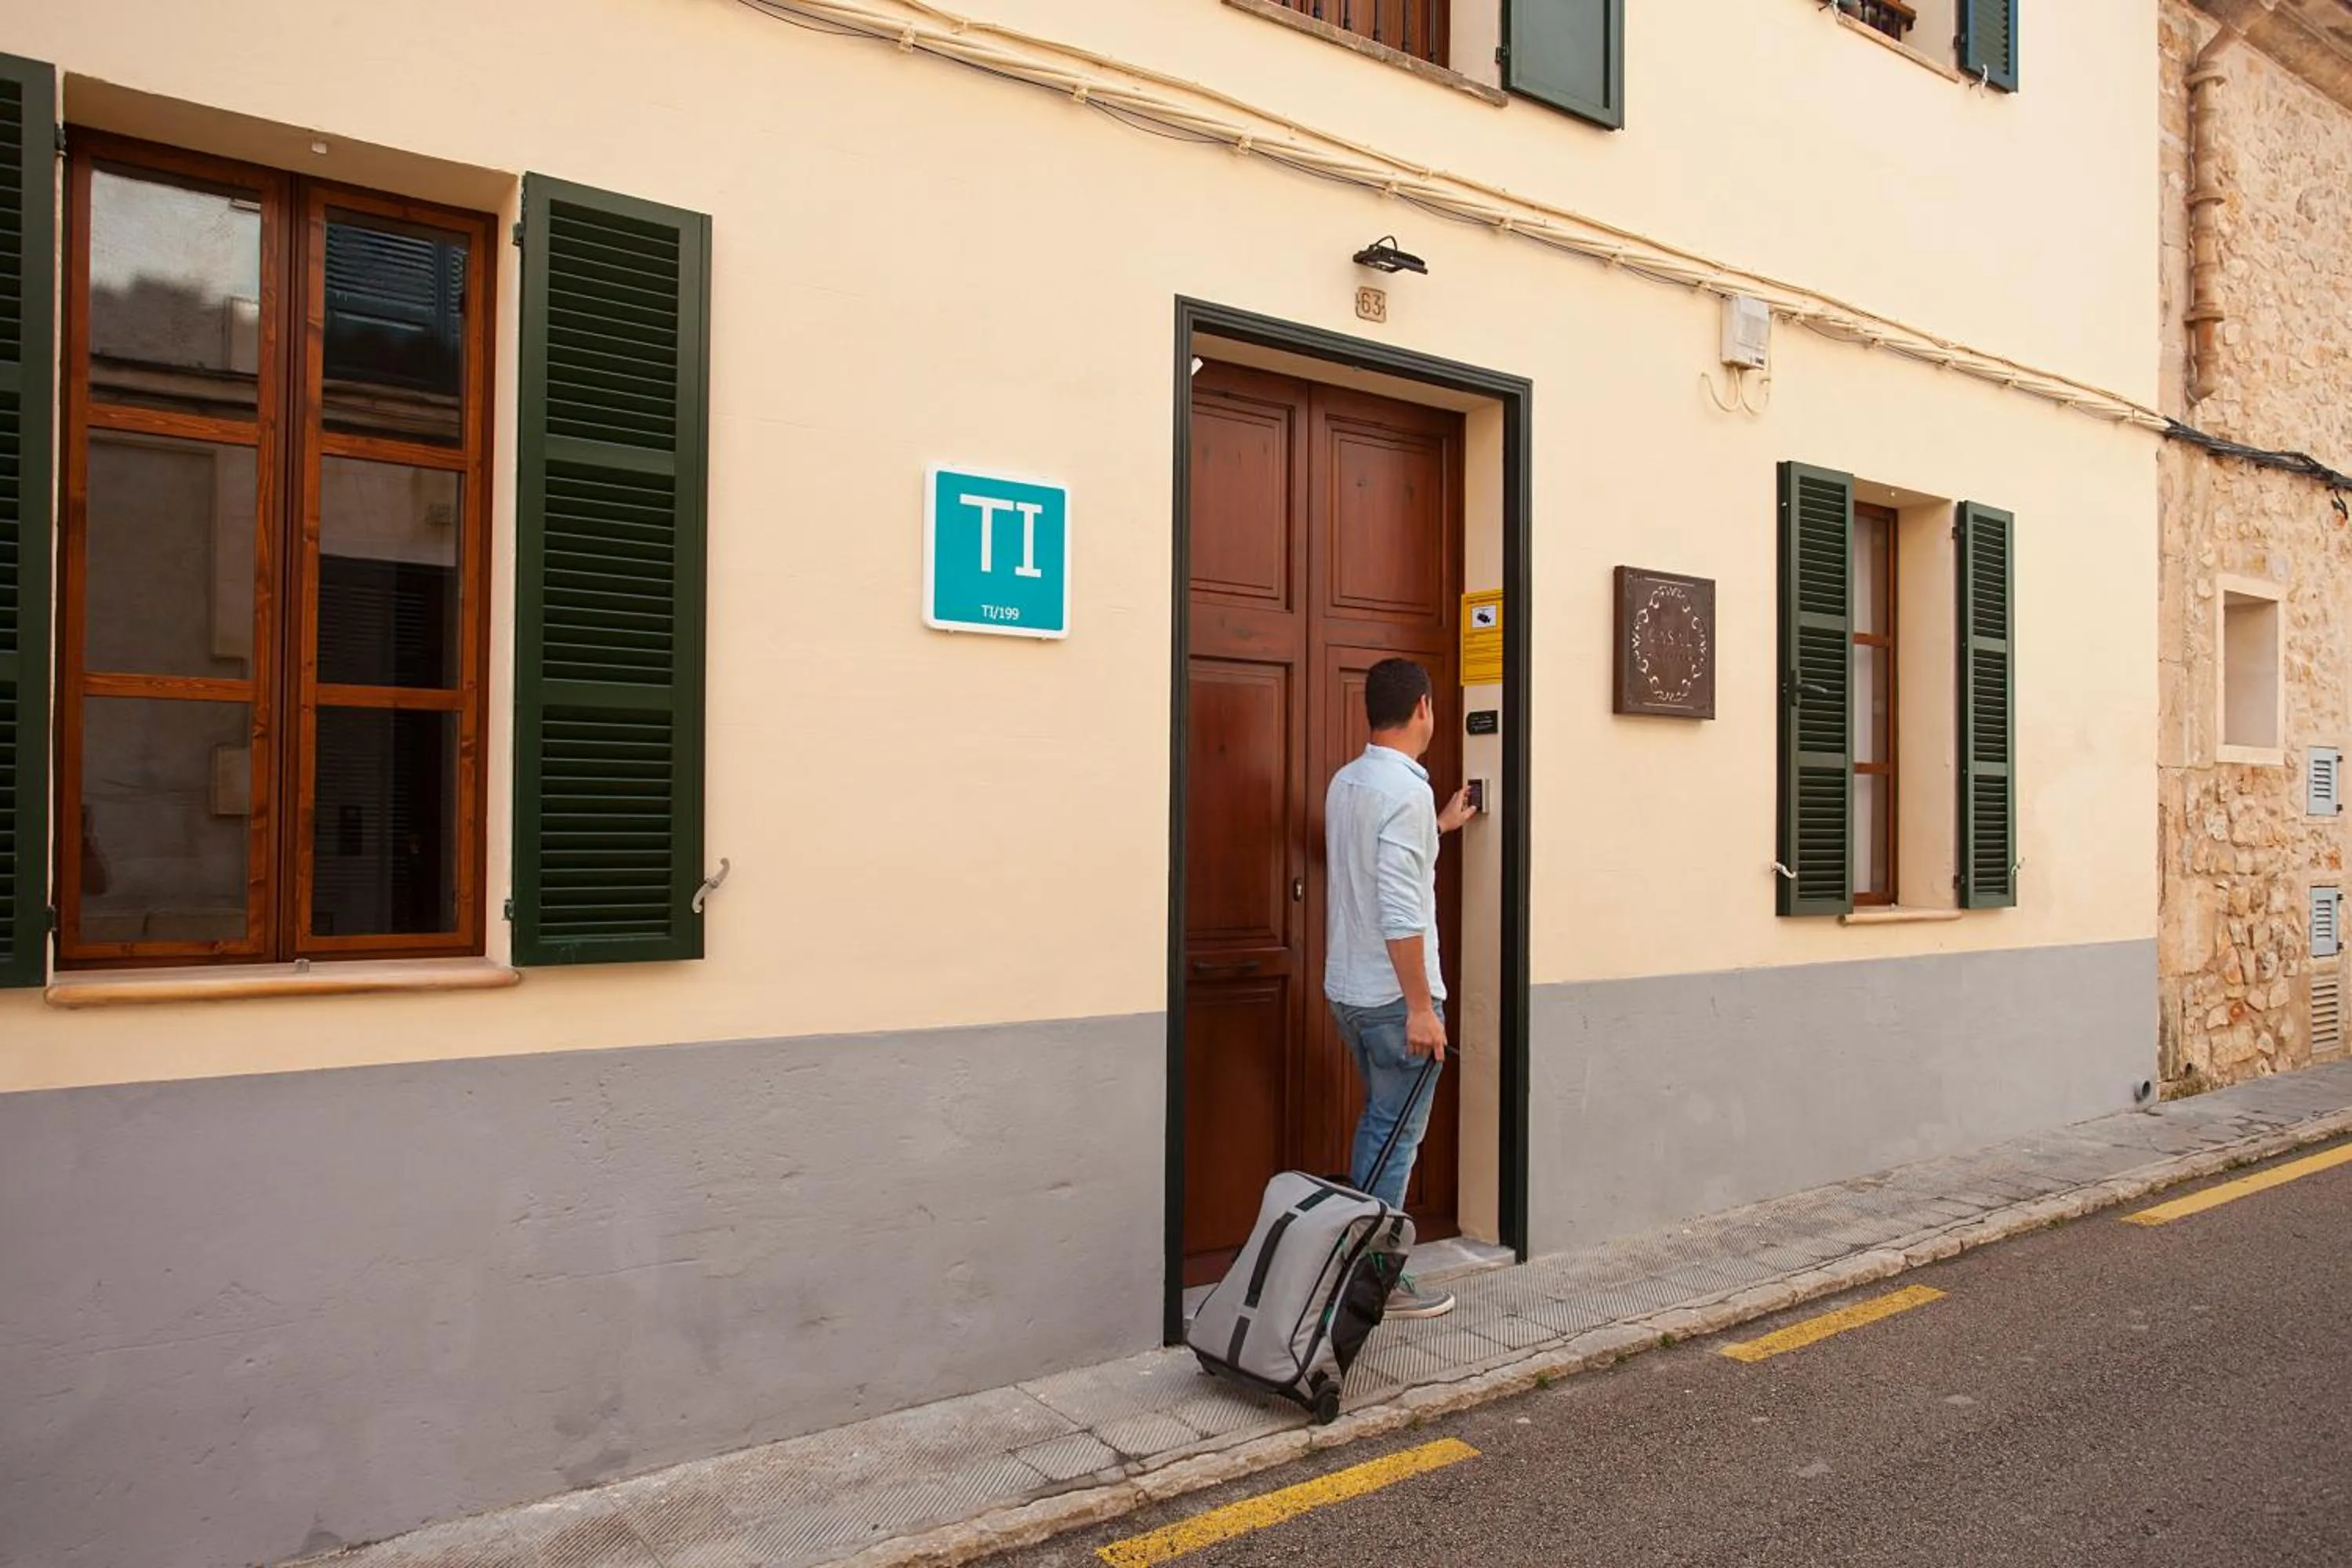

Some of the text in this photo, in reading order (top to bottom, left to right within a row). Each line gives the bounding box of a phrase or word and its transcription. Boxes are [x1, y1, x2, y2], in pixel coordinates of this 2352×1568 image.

[1361, 292, 1381, 315] 63
[960, 493, 1043, 578] TI
[980, 604, 1019, 620] TI/199
